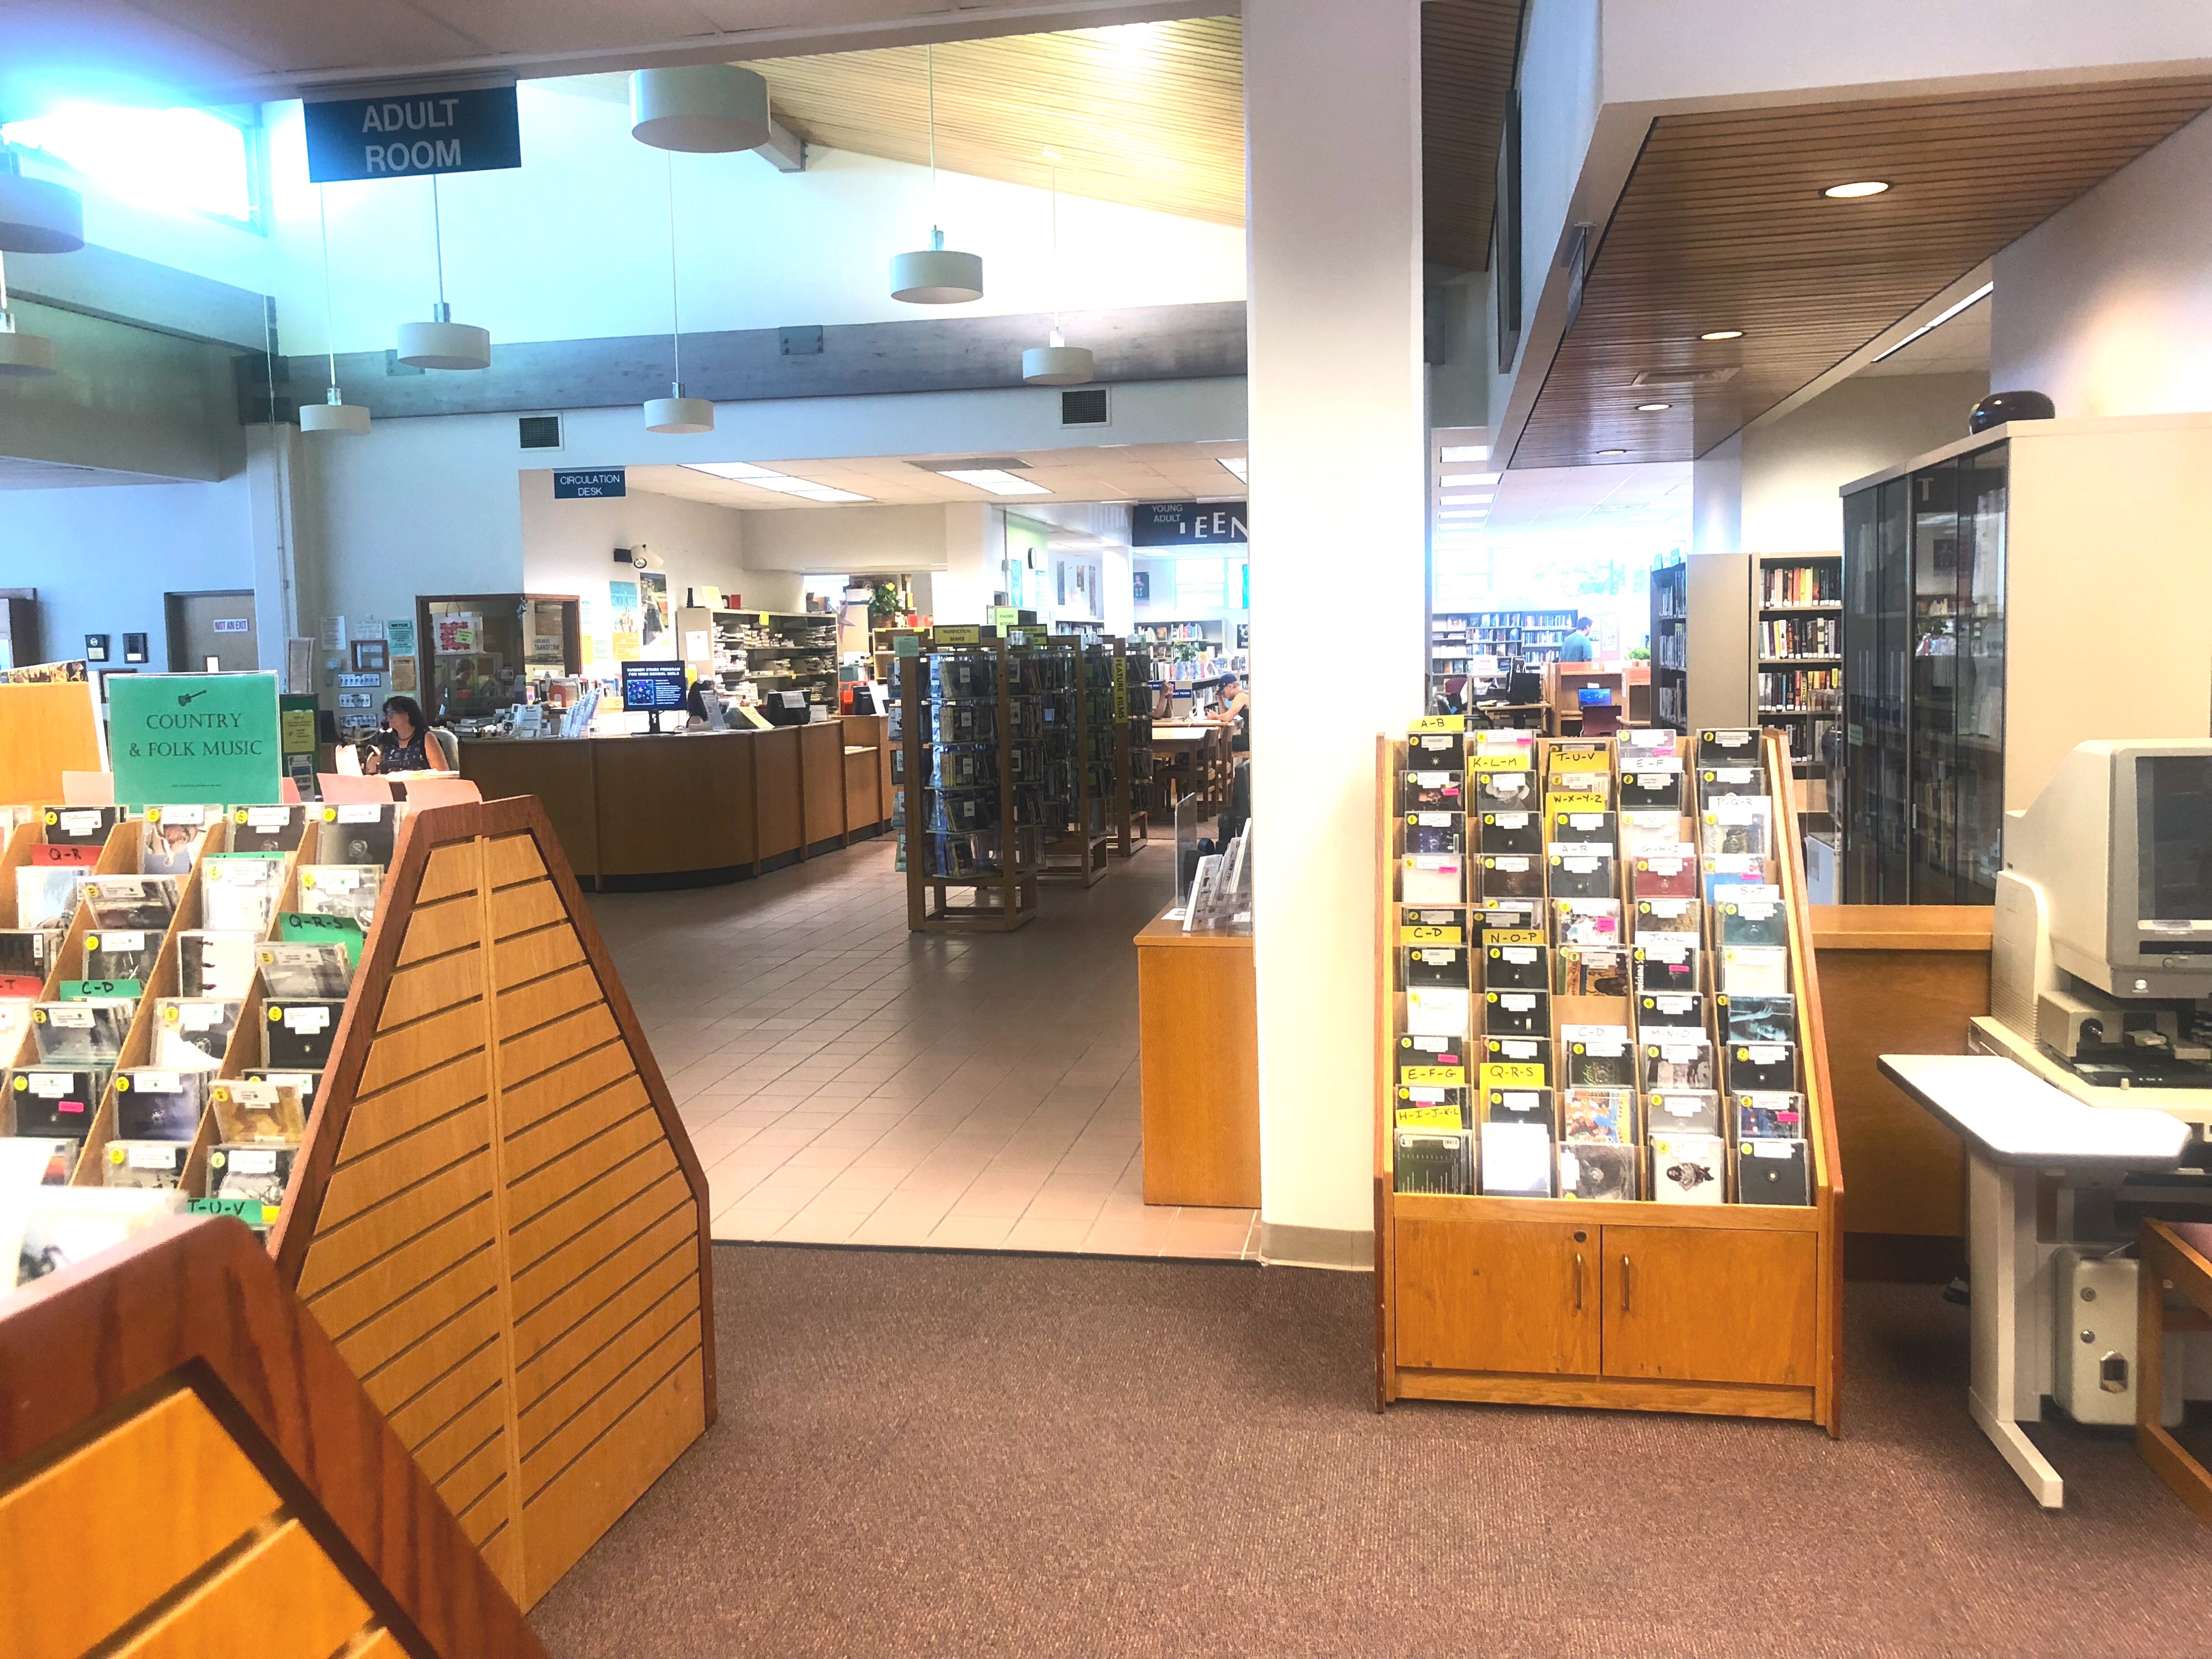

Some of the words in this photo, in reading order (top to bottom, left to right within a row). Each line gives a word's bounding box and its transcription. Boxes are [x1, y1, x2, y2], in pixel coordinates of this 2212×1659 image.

[362, 98, 460, 133] ADULT
[366, 139, 462, 173] ROOM
[560, 474, 620, 486] CIRCULATION
[578, 487, 603, 496] DESK
[1152, 504, 1183, 513] YOUNG
[1154, 514, 1182, 523] ADULT
[215, 621, 226, 630] NOT
[227, 620, 235, 630] AN
[236, 620, 247, 629] EXIT
[1115, 659, 1124, 692] FEATURE
[1117, 697, 1125, 719] FILMS
[146, 712, 242, 729] COUNTRY
[129, 742, 142, 757] &
[148, 741, 196, 757] FOLK
[202, 740, 263, 756] MUSIC
[1556, 752, 1595, 761] T-U-V
[1473, 758, 1517, 768] K-L-M
[1553, 794, 1603, 803] W-X-Y-Z
[1490, 932, 1537, 943] N-O-P
[1408, 1068, 1457, 1080] E-F-G
[1490, 1065, 1534, 1078] Q-R-S
